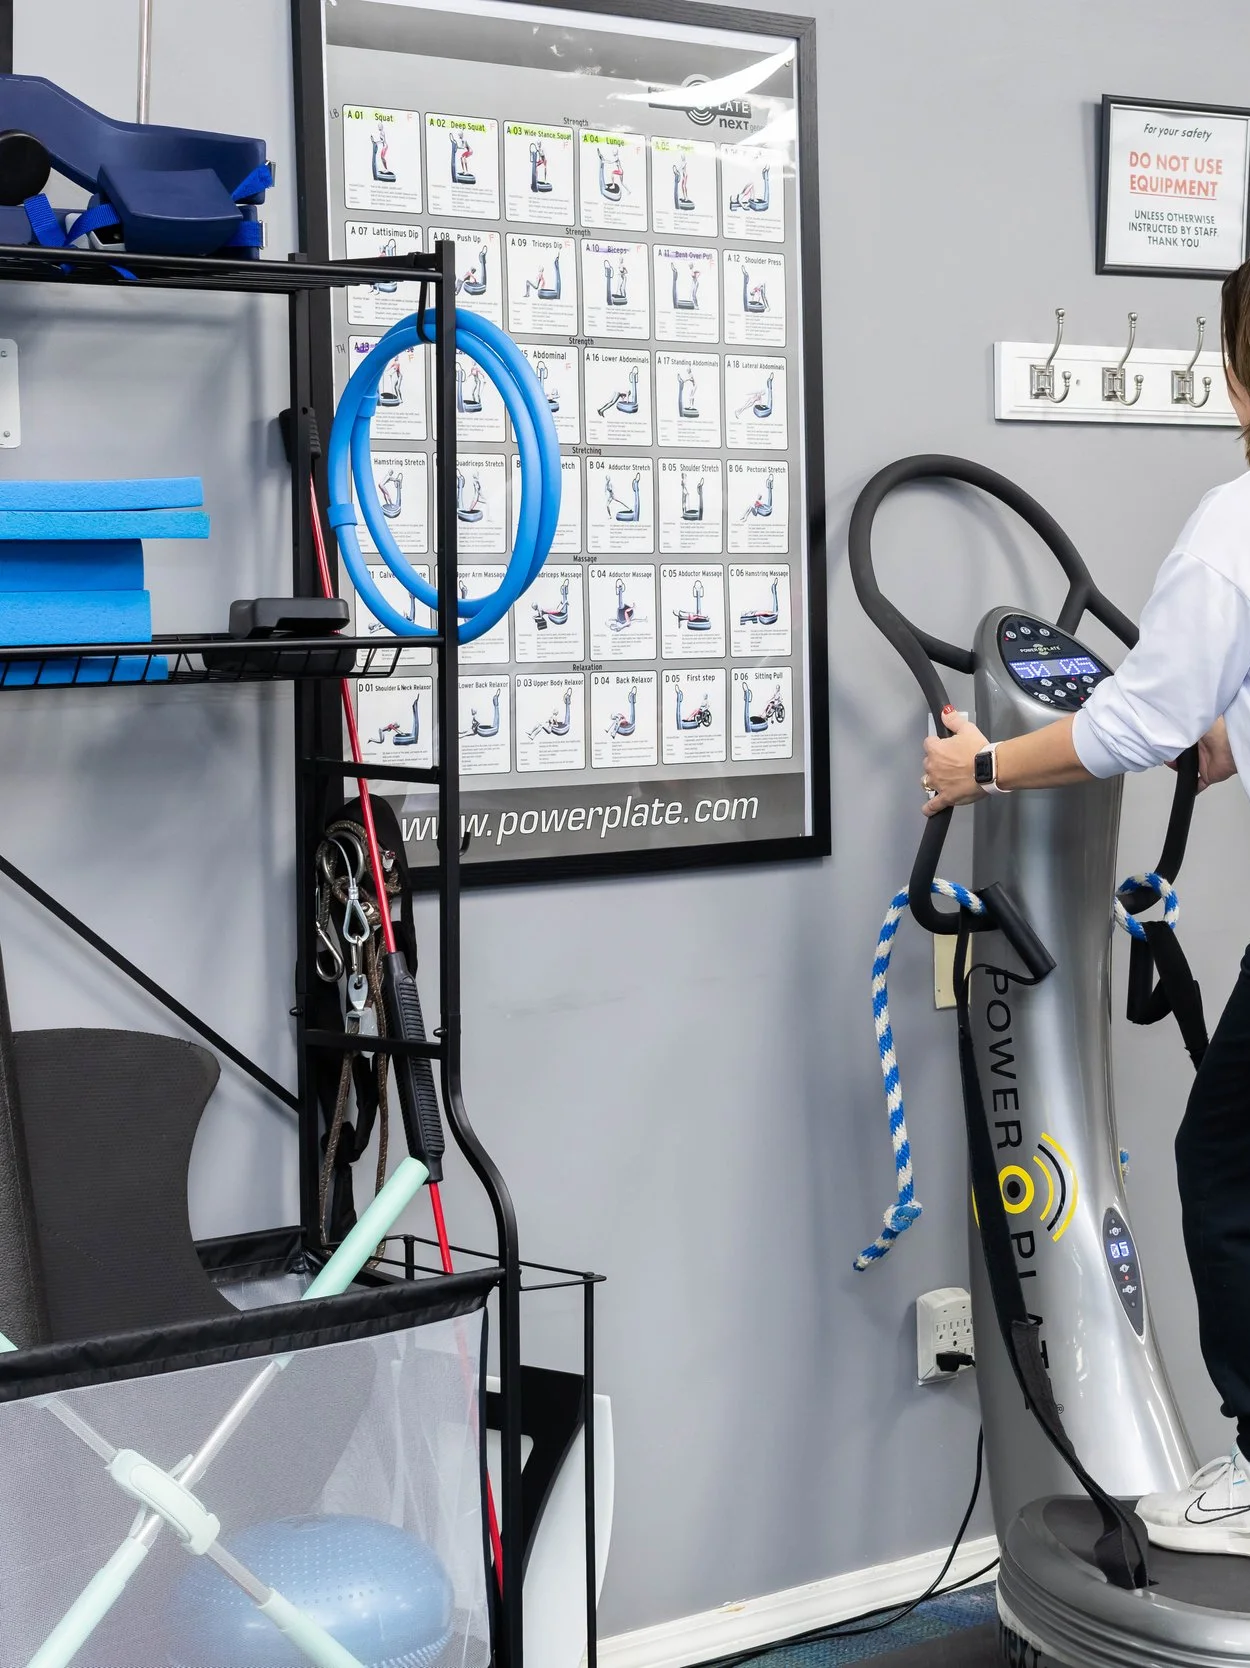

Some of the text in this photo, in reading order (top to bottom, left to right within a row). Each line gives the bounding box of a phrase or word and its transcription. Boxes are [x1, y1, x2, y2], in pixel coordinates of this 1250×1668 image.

[348, 110, 393, 122] A 01 Squat
[430, 118, 485, 132] A 02 Deep Squat
[564, 117, 588, 127] Strength
[513, 127, 522, 135] 03
[1144, 124, 1212, 142] For your safety
[584, 134, 624, 146] A 04 Lunge
[1130, 152, 1222, 174] DO NOT USE
[1130, 175, 1218, 196] EQUIPMENT
[1135, 210, 1215, 224] UNLESS OTHERWISE
[351, 227, 418, 239] A 07 Lattisimus Dip
[566, 228, 591, 236] Strength
[1129, 222, 1177, 234] INSTRUCTED
[1181, 226, 1191, 235] BY
[434, 232, 481, 243] A 08 Push Up
[1148, 236, 1199, 247] THANK YOU
[518, 239, 527, 247] 09
[532, 240, 552, 249] Triceps
[554, 241, 562, 250] Dip
[586, 244, 627, 254] A 10 Biceps
[664, 249, 670, 257] 11
[676, 250, 688, 258] Bent
[689, 251, 700, 259] Over
[702, 252, 712, 260] Pull
[728, 254, 733, 262] A
[745, 256, 766, 265] Shoulder
[768, 257, 782, 266] Press
[355, 342, 358, 350] A
[569, 337, 594, 346] Strength
[533, 350, 566, 360] Abdominal
[586, 353, 649, 364] A 16 Lower Abdominals
[663, 357, 670, 365] 17
[671, 359, 691, 367] Standing
[692, 359, 718, 367] Abdominals
[727, 360, 732, 368] A
[759, 363, 784, 371] Abdominals
[572, 447, 602, 455] Stretching
[374, 458, 425, 467] Hamstring Stretch
[590, 462, 594, 470] B
[596, 461, 605, 470] 04
[662, 463, 719, 472] B 05 Shoulder Stretch
[573, 555, 597, 563] Massage
[561, 571, 582, 579] Massage
[591, 570, 595, 578] C
[597, 570, 606, 578] 04
[702, 570, 722, 578] Massage
[730, 569, 735, 577] C
[736, 569, 744, 577] 06
[745, 570, 768, 578] Hamstring
[632, 676, 653, 684] Relaxor
[666, 675, 670, 683] D
[702, 674, 715, 682] step
[772, 672, 783, 680] Pull
[359, 684, 364, 692] D
[365, 684, 373, 692] 01
[985, 968, 1022, 1149] POWER
[1110, 1242, 1129, 1258] 05
